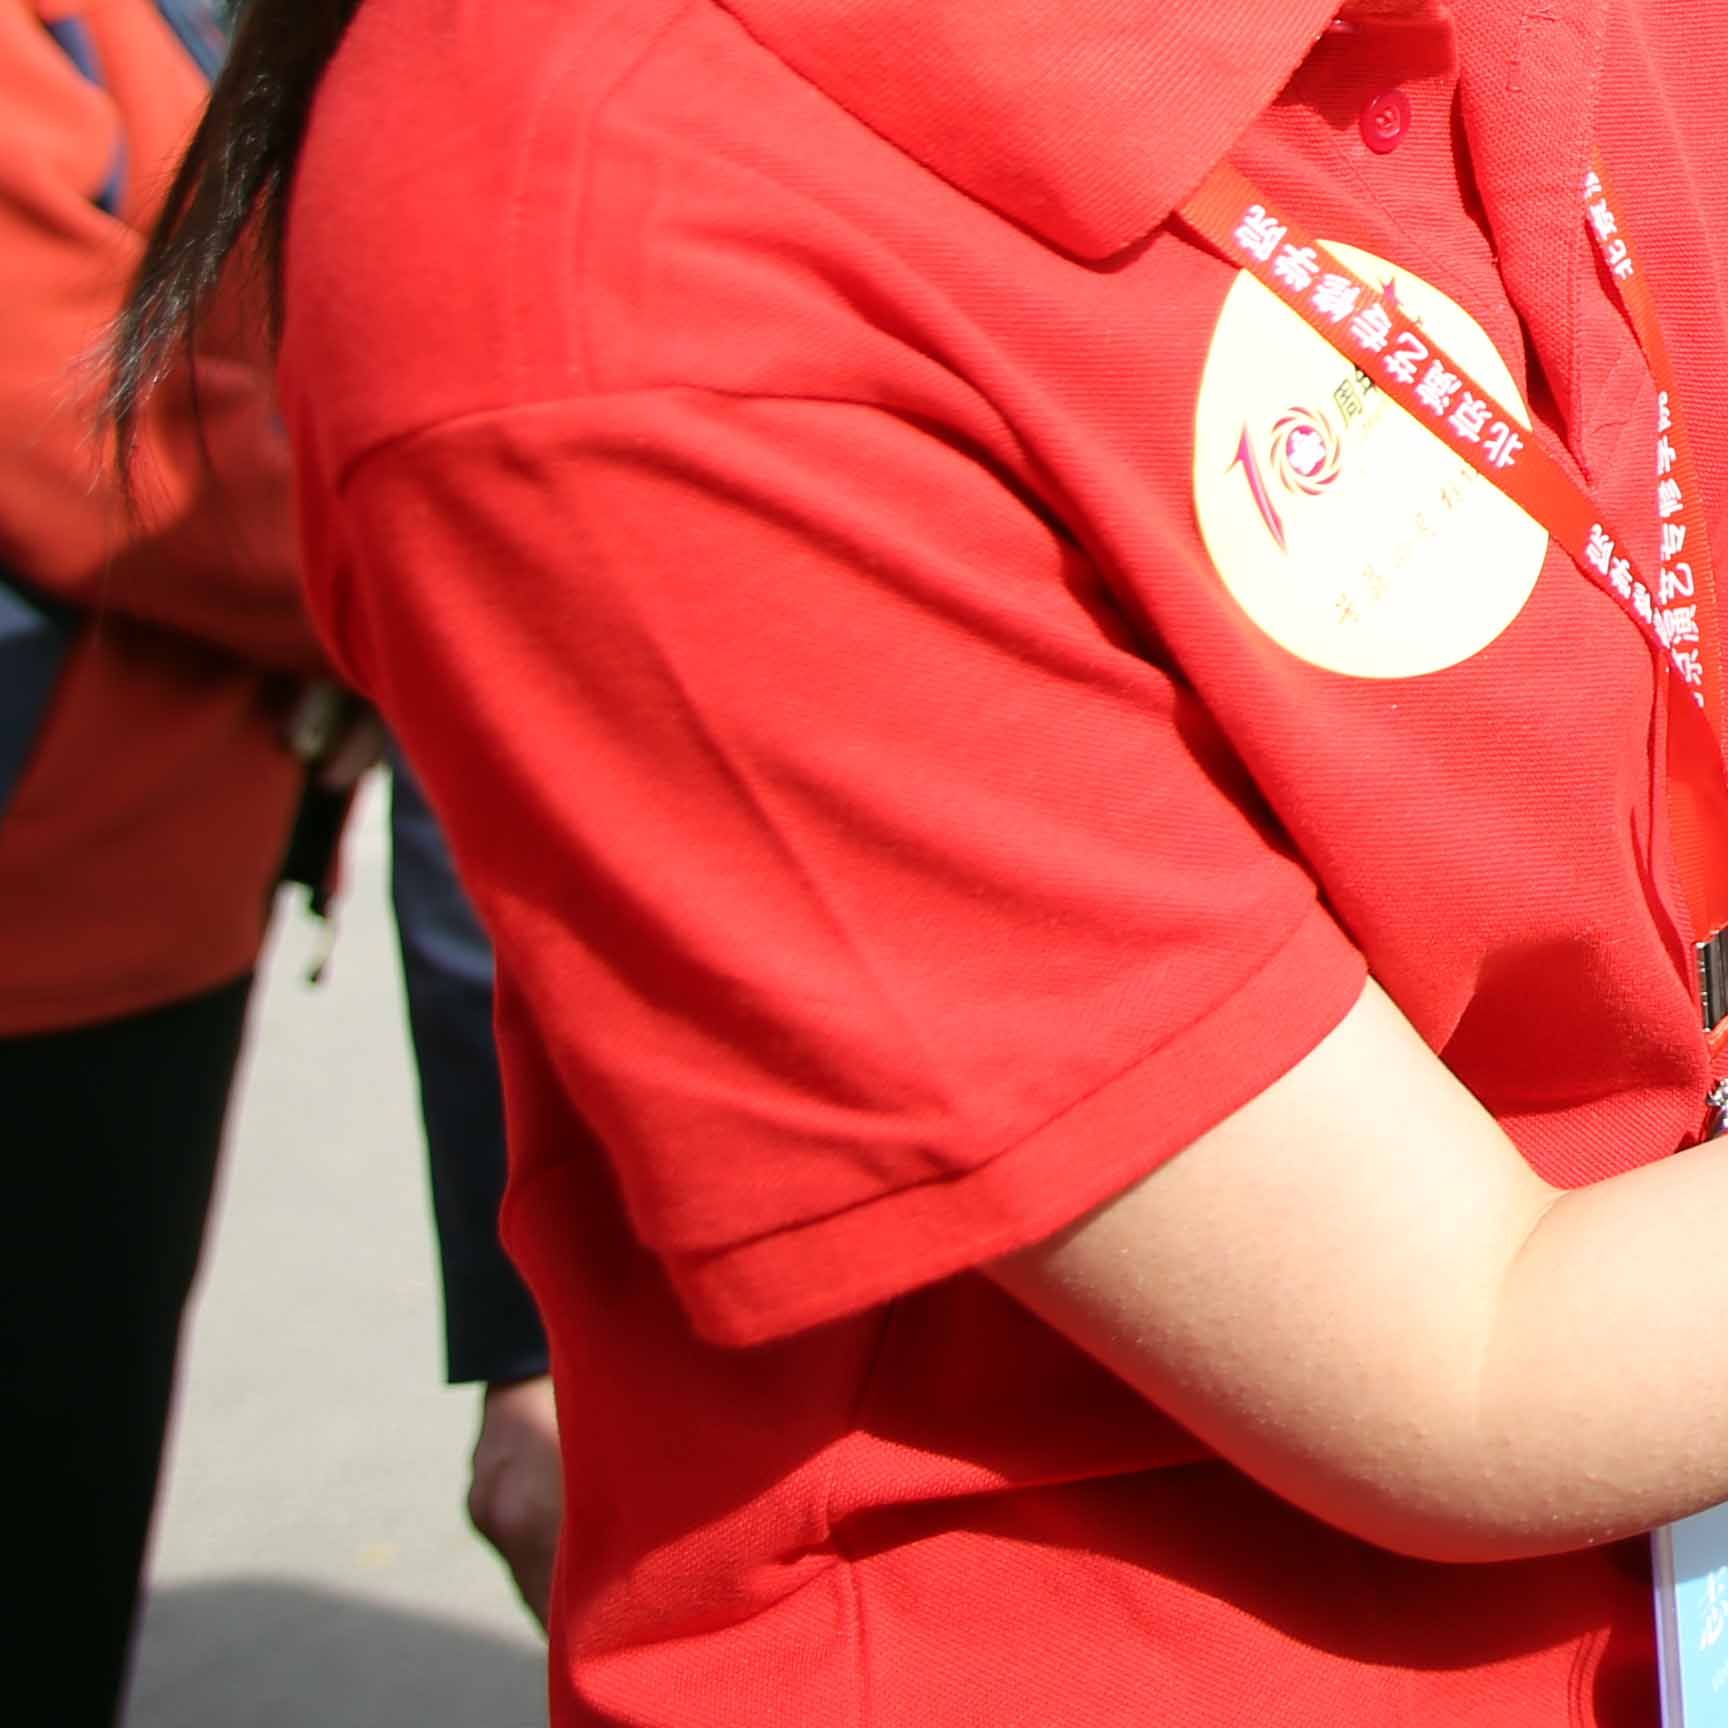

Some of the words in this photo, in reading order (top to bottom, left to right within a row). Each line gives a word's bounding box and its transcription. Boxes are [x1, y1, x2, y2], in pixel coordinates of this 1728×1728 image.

[1234, 204, 1524, 469] 北京演艺专修学院
